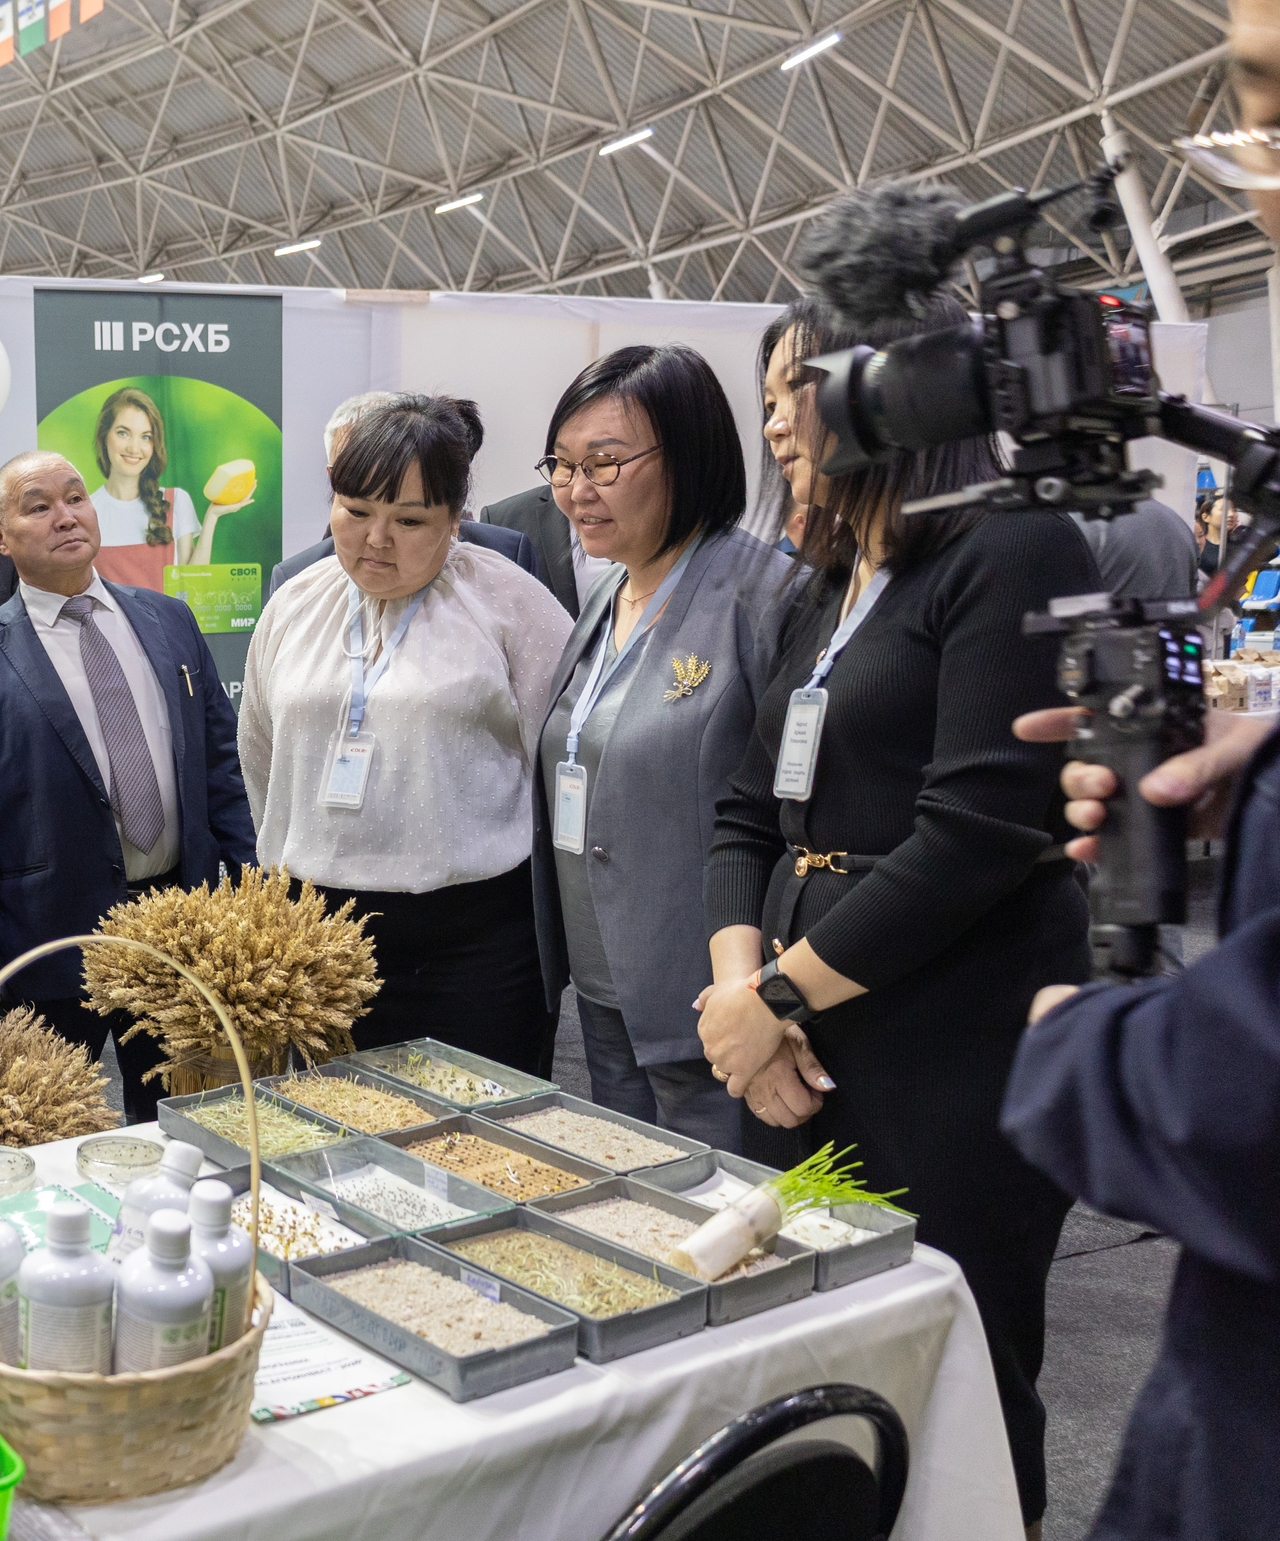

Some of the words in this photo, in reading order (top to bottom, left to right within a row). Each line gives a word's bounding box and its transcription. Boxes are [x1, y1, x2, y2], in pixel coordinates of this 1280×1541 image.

[131, 322, 230, 352] РСХБ
[230, 568, 257, 576] СВОЯ
[231, 618, 255, 628] МИР
